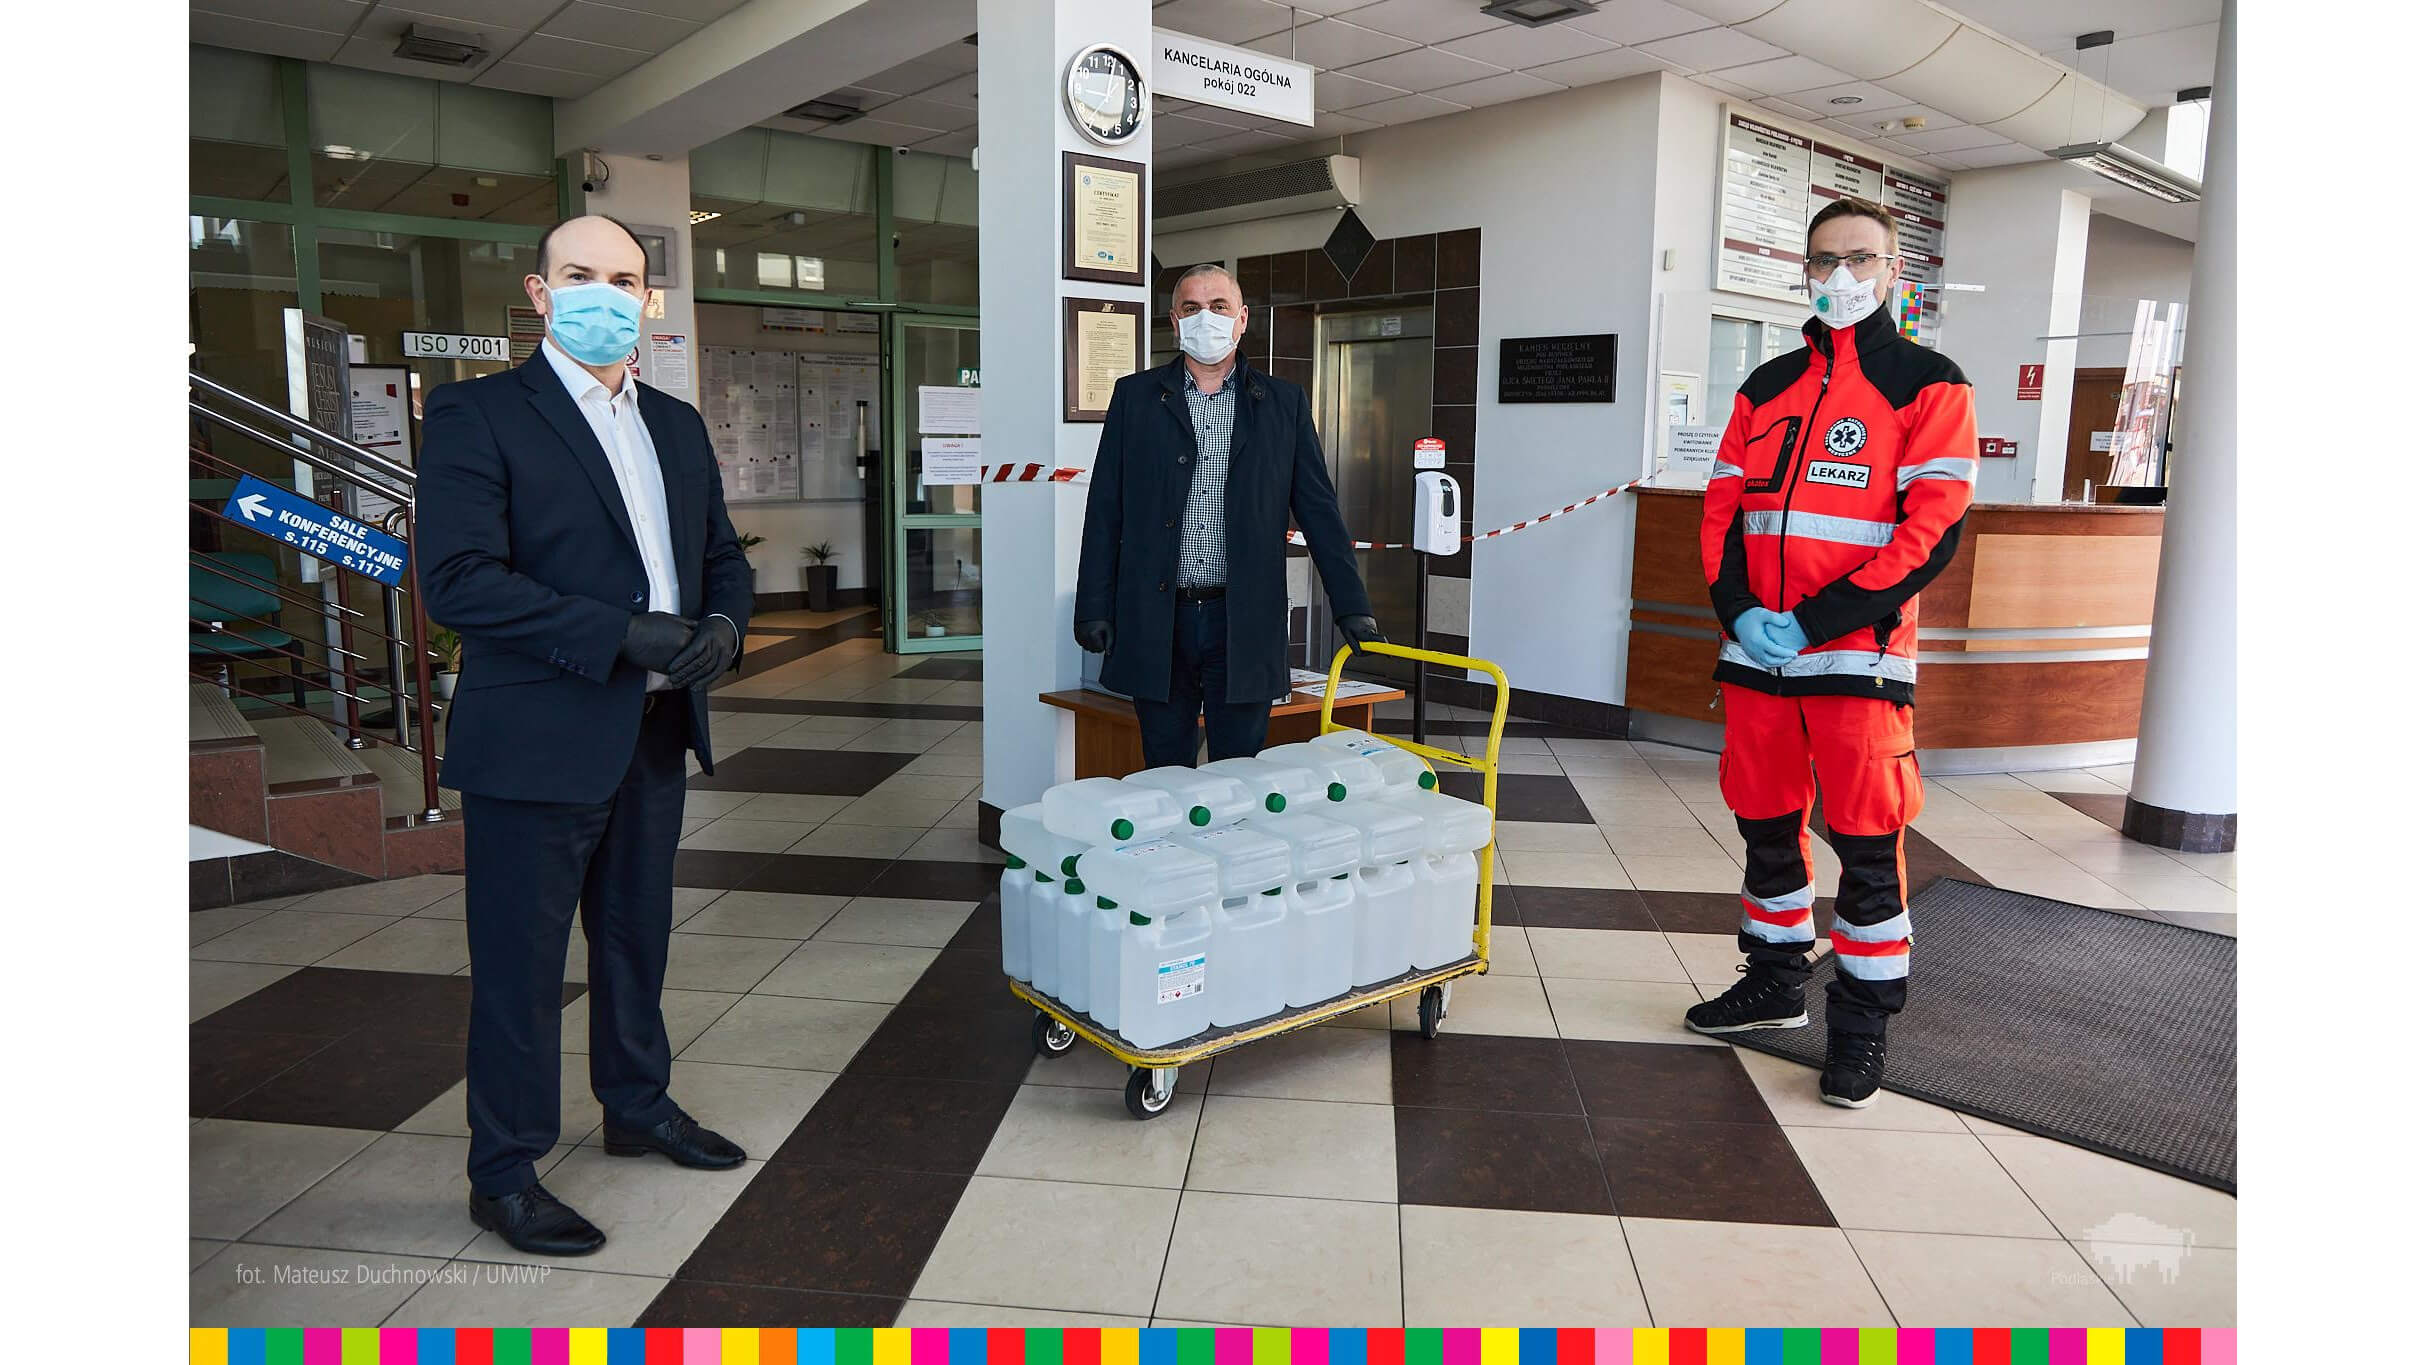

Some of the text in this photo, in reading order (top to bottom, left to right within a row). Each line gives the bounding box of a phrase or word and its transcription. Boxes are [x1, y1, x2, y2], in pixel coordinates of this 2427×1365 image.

[1088, 55, 1098, 69] 11
[1164, 48, 1291, 89] KANCELARIA OGÓLNA
[1078, 66, 1090, 79] 10
[1119, 64, 1124, 75] 1
[1128, 79, 1135, 91] 2
[1204, 77, 1256, 97] pokój 022
[1130, 97, 1137, 108] 3
[1126, 113, 1133, 125] 4
[1101, 125, 1109, 136] 6
[1114, 122, 1122, 134] 5
[414, 335, 502, 356] ISO 9001
[961, 369, 979, 384] PA
[1811, 466, 1866, 483] LEKARZ
[329, 515, 368, 540] SALE
[278, 509, 403, 571] KONFERENCYJNE
[284, 531, 385, 577] s.115 s.117
